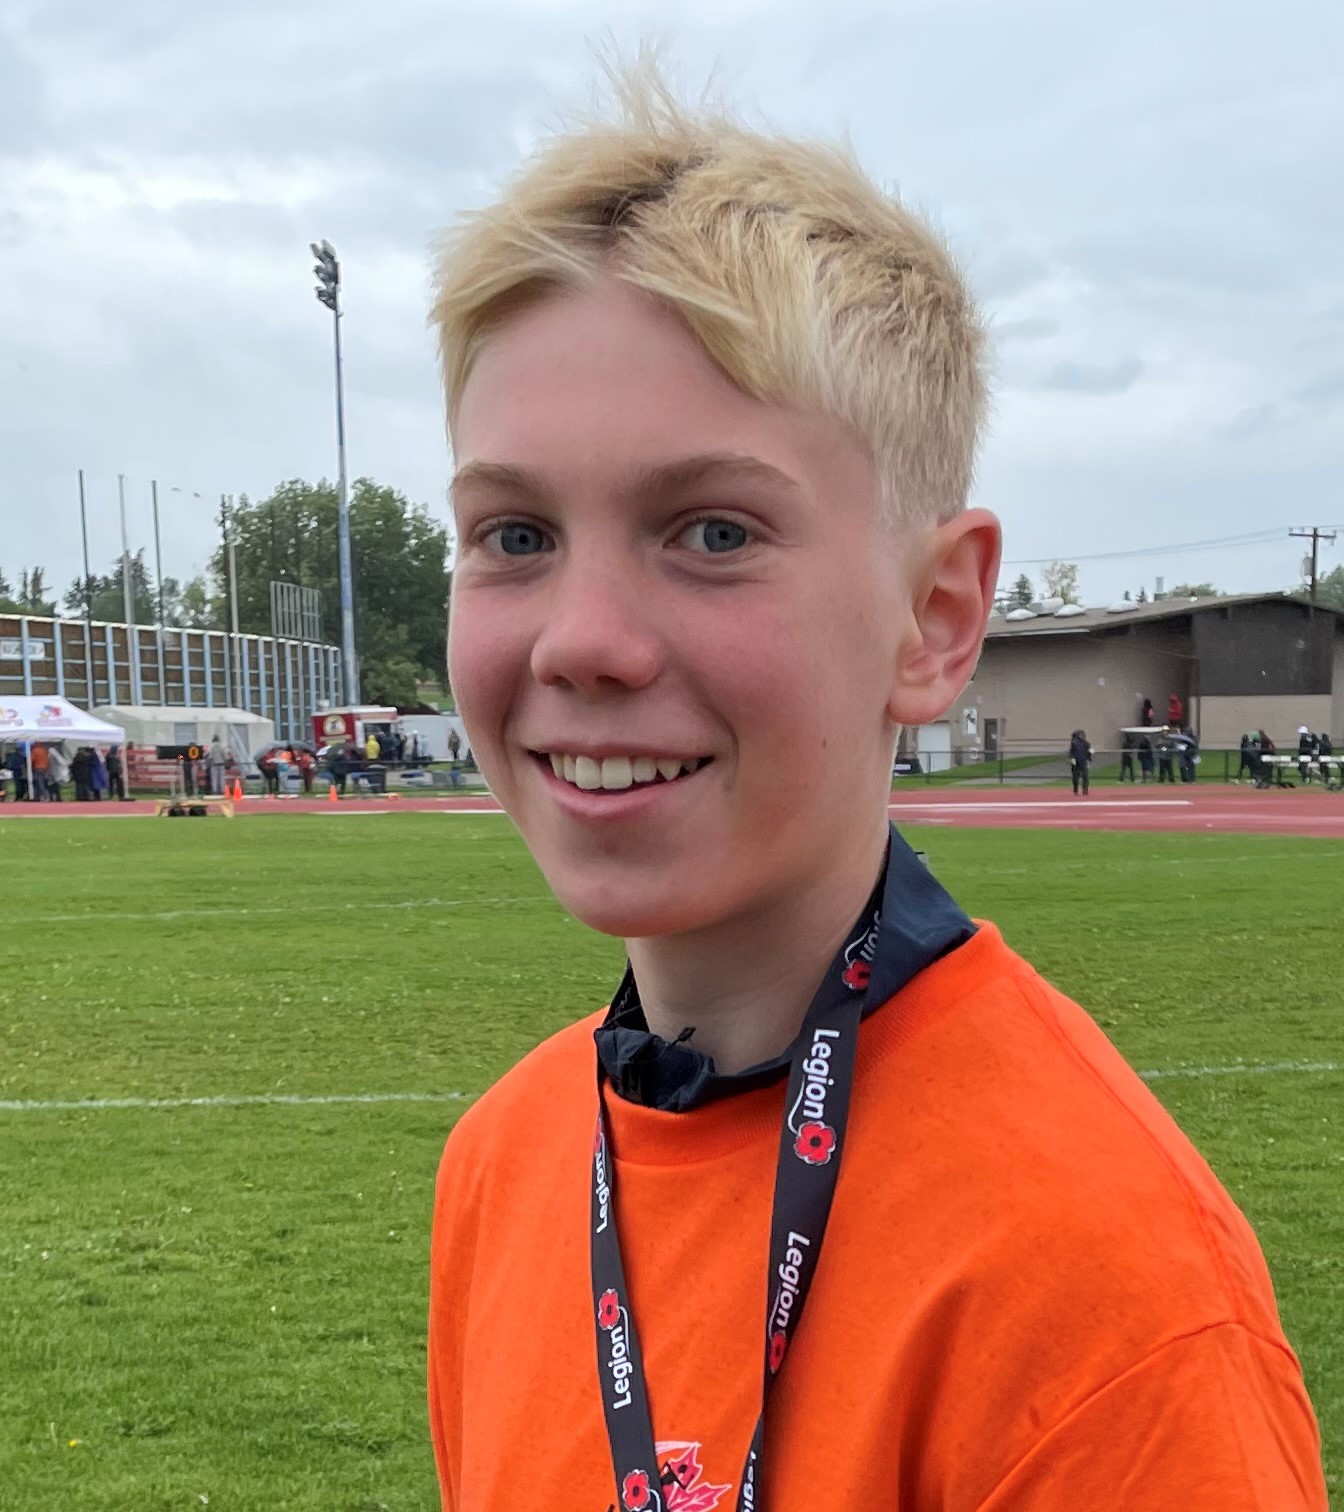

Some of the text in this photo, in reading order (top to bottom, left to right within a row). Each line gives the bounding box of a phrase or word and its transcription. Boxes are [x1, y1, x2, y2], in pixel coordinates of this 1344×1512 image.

[802, 1029, 840, 1119] Legion
[596, 1152, 610, 1233] Legion
[777, 1231, 810, 1328] Legion
[608, 1326, 633, 1410] Legion
